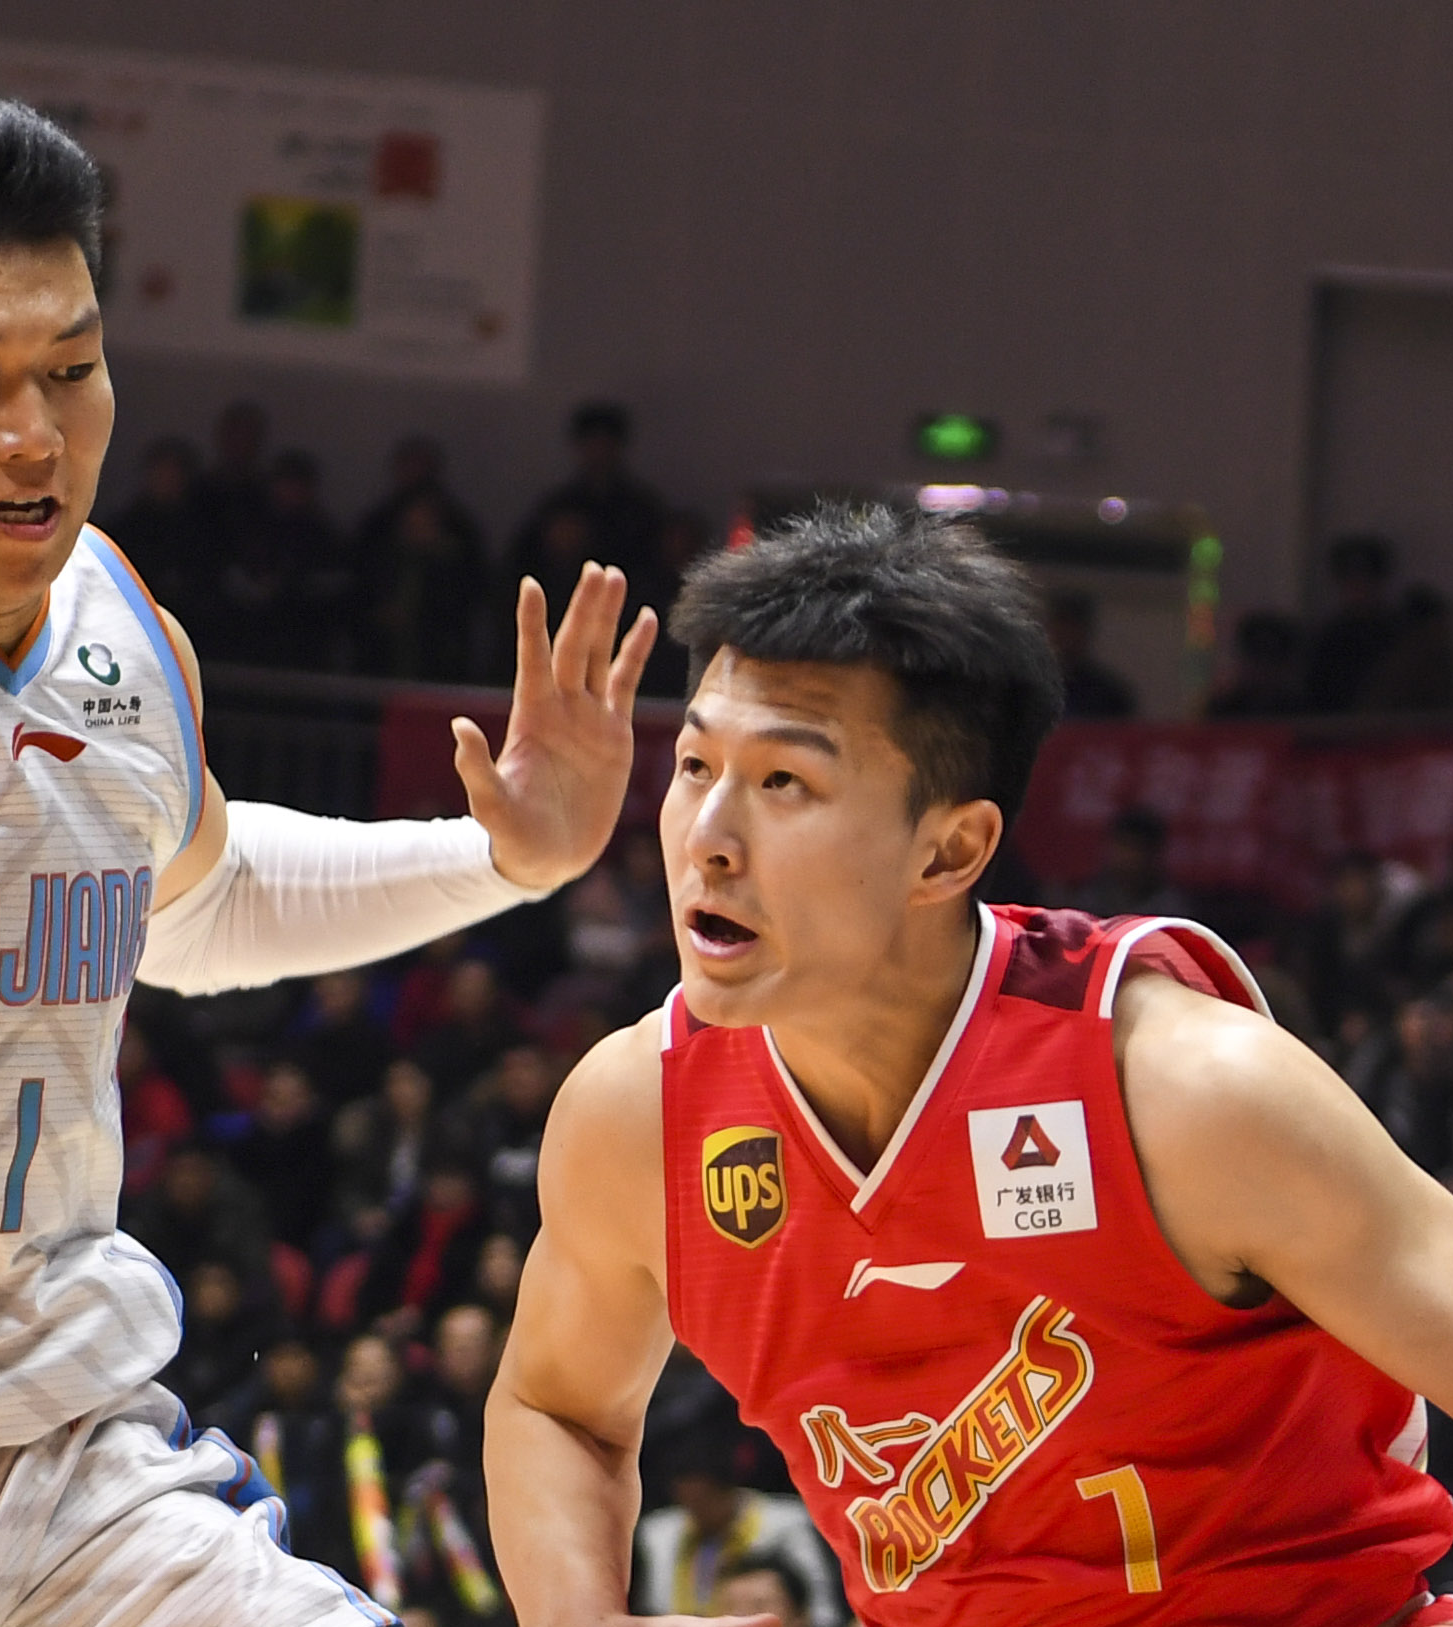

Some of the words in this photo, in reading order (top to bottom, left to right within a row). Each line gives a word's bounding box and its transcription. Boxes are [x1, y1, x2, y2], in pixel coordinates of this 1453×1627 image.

[83, 696, 142, 716] 中国人寿
[85, 717, 114, 728] CHINA
[118, 715, 141, 726] LIFE
[708, 1163, 782, 1231] ups
[996, 1181, 1075, 1207] 广发银行
[1014, 1208, 1063, 1231] CGB
[800, 1405, 938, 1488] 八一
[846, 1295, 1095, 1593] ROCKETS
